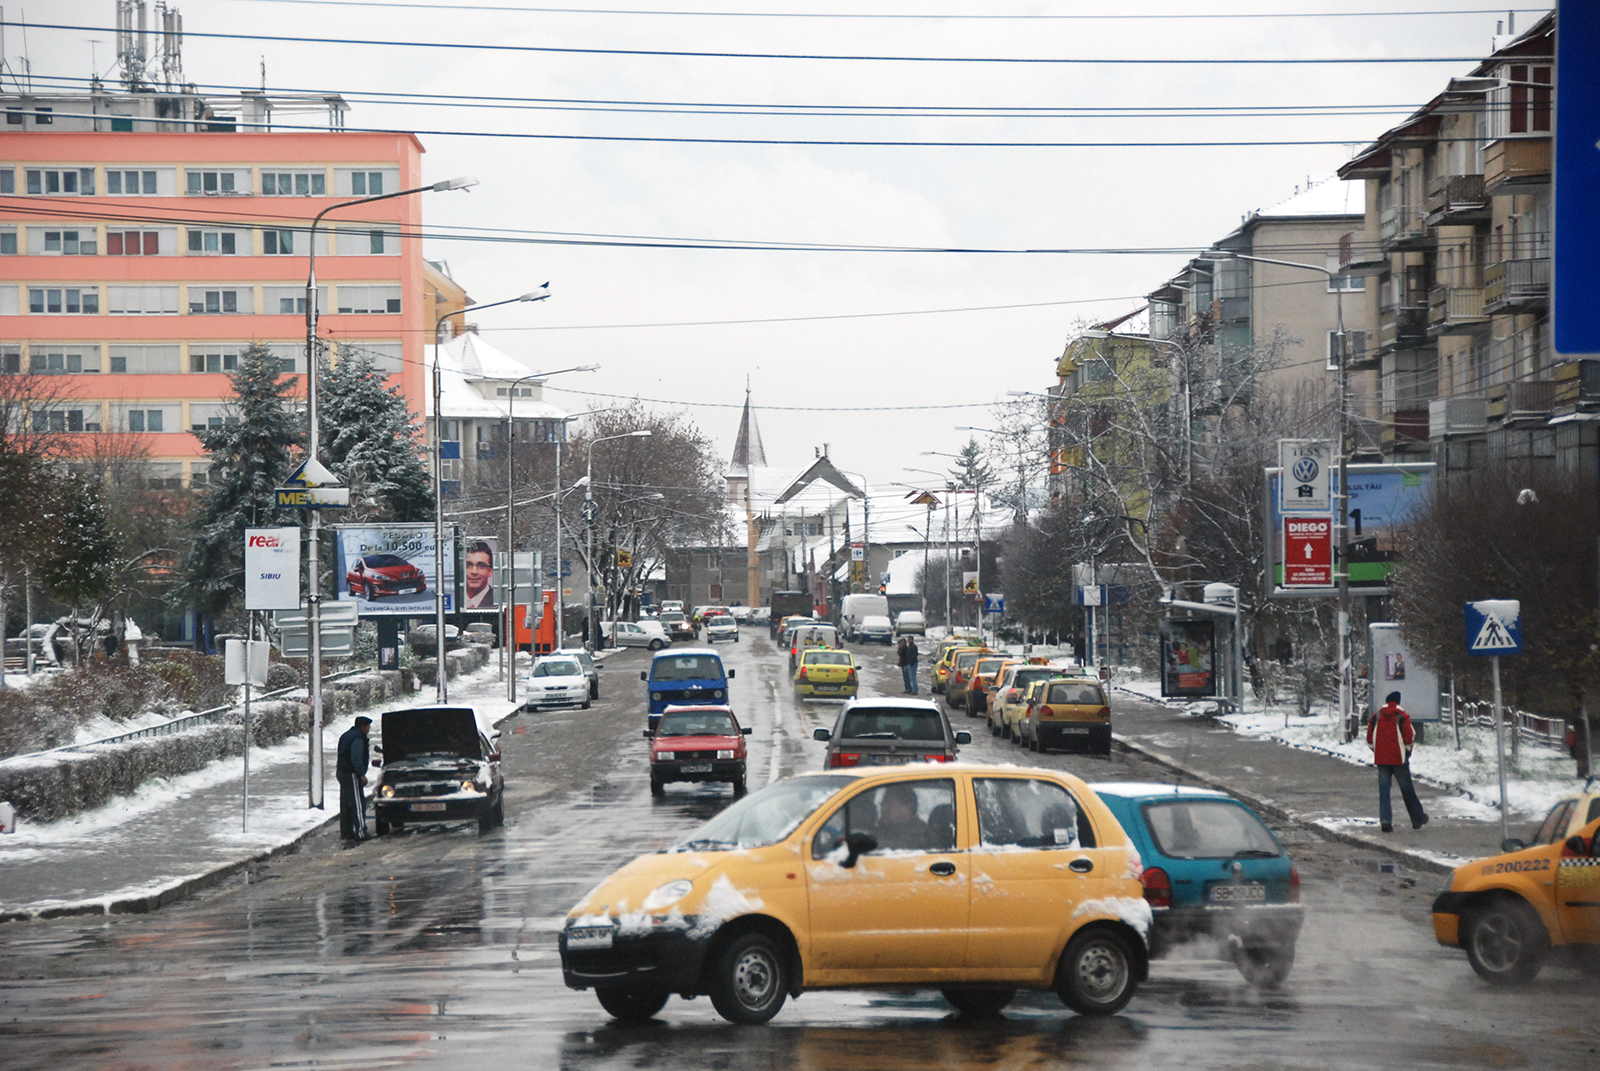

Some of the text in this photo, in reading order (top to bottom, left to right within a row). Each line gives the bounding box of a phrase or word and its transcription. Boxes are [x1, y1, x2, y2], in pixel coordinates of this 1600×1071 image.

[1288, 522, 1328, 532] DIEGO
[1349, 508, 1362, 536] 1
[386, 541, 422, 551] 10.500
[1495, 858, 1551, 874] 200222
